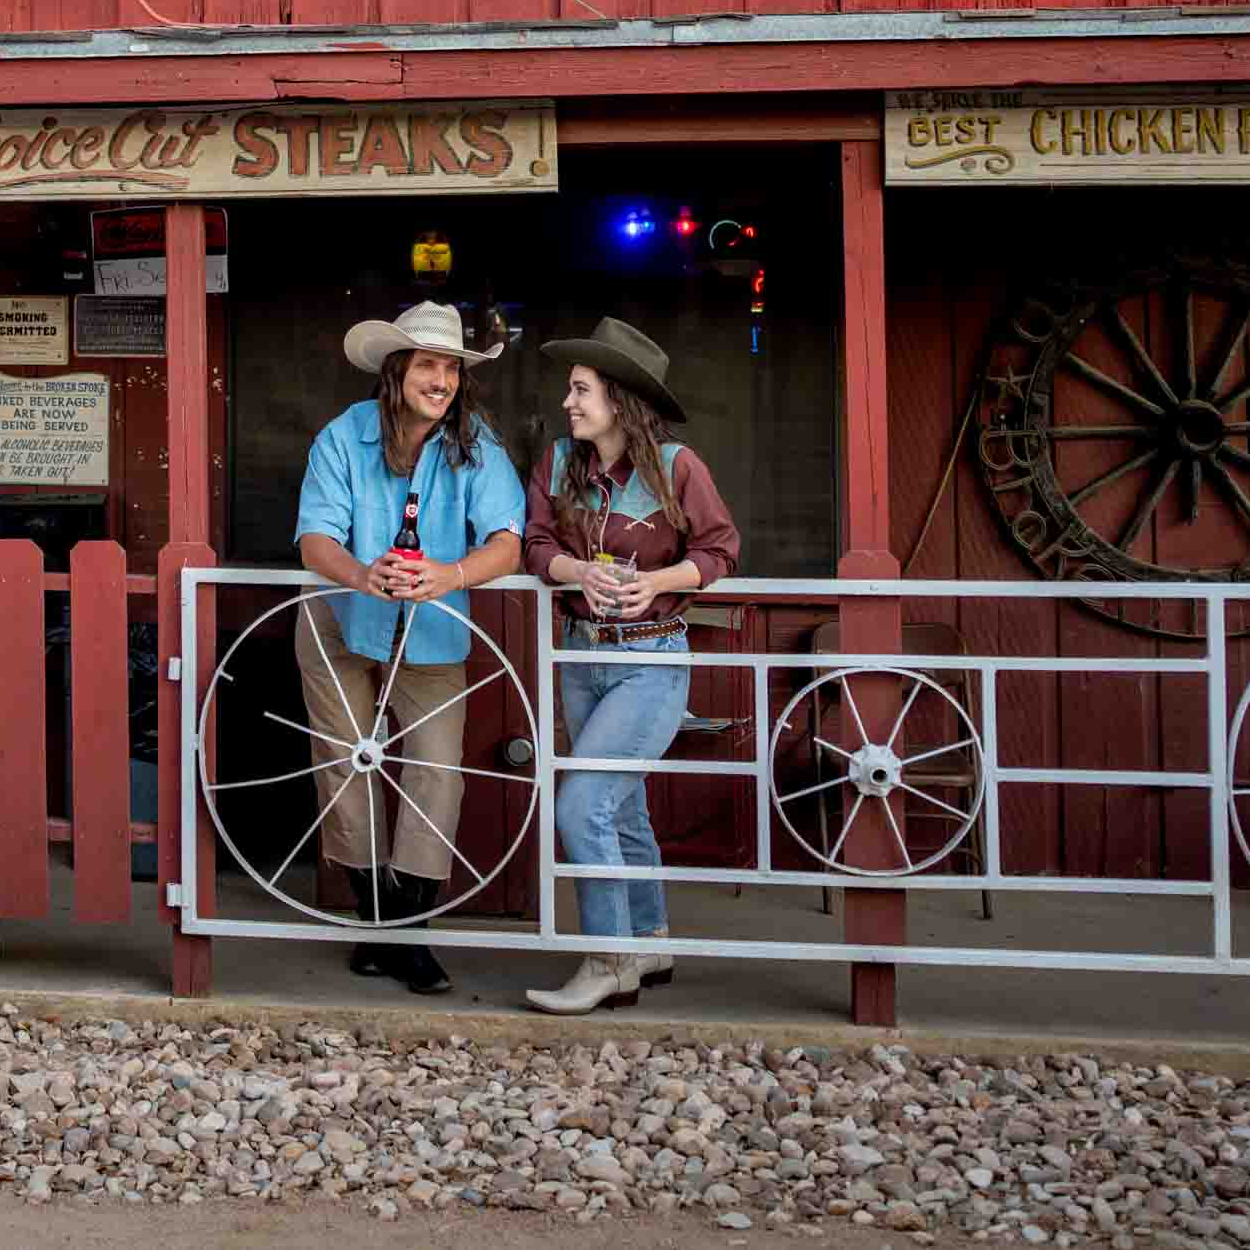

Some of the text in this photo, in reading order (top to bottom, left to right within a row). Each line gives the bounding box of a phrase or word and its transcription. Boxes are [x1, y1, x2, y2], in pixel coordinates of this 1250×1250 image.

[907, 116, 1002, 147] BEST
[1030, 107, 1227, 156] CHICKEN
[109, 109, 221, 170] Cut
[231, 108, 514, 177] STEAKS
[45, 381, 76, 392] BROKEN
[77, 381, 105, 393] SPOKE
[30, 396, 97, 408] BEVERAGES
[13, 407, 76, 419] ARE NOW
[1, 420, 89, 432] BEING SERVED
[51, 440, 104, 453] BEVERAGES
[9, 452, 22, 463] BE
[25, 453, 74, 465] BROUGHT
[77, 453, 90, 464] IN
[10, 465, 43, 477] TAKEN
